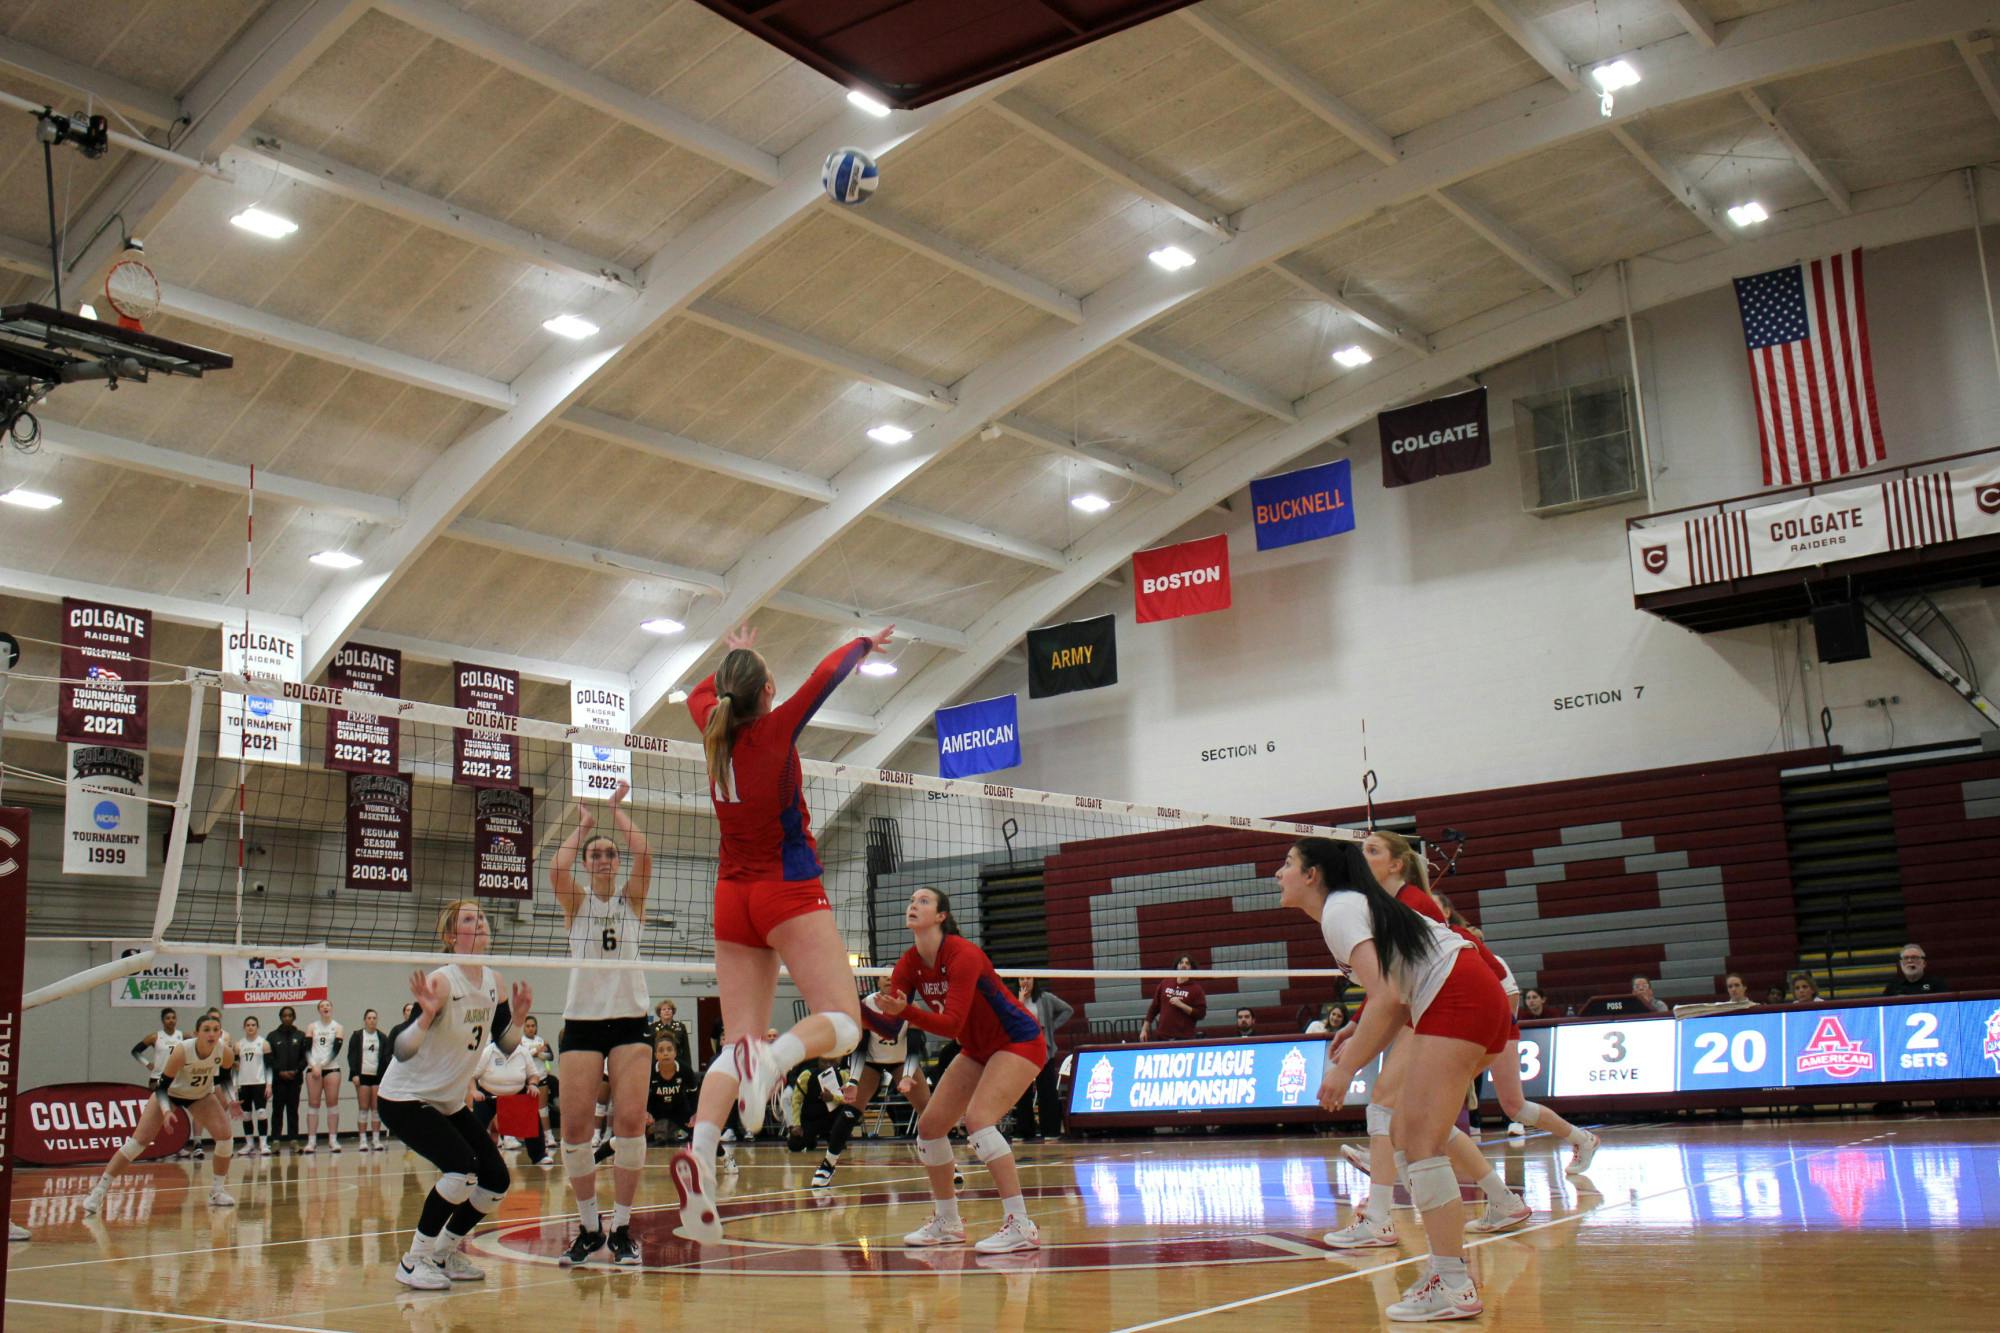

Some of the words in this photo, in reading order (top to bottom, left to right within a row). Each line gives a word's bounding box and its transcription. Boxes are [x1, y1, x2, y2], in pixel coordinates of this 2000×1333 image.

[1392, 422, 1478, 454] COLGATE
[1257, 488, 1344, 524] BUCKNELL
[1770, 507, 1863, 542] COLGATE
[1791, 536, 1846, 552] RAIDERS
[1647, 550, 1664, 568] C
[1143, 566, 1220, 594] BOSTON
[70, 608, 144, 638] COLGATE
[84, 631, 130, 643] RAIDERS
[229, 634, 294, 659] COLGATE
[335, 649, 394, 676] COLGATE
[1051, 645, 1094, 670] ARMY
[346, 669, 382, 681] RAIDERS
[460, 671, 514, 695] COLGATE
[283, 682, 342, 705] COLGATE
[353, 680, 375, 691] MEN'S
[73, 688, 136, 704] TOURNAMENT
[471, 690, 503, 700] RAIDERS
[577, 690, 625, 711] COLGATE
[1554, 689, 1622, 711] SECTION
[1634, 686, 1645, 700] 7
[72, 698, 136, 714] CHAMPIONS
[84, 715, 123, 735] 2021
[466, 711, 517, 731] COLGATE
[244, 734, 277, 750] 2021
[337, 729, 388, 745] CHAMPIONS
[624, 734, 668, 752] COLGATE
[942, 723, 1013, 754] AMERICAN
[464, 740, 510, 751] TOURNAMENT
[1201, 744, 1257, 762] SECTION
[1266, 740, 1276, 753] 6
[335, 744, 390, 764] 2021-22
[464, 748, 510, 761] CHAMPIONS
[462, 760, 512, 780] 2021-22
[578, 761, 626, 774] TOURNAMENT
[588, 775, 617, 790] 2022
[880, 770, 914, 785] COLGATE
[984, 784, 1014, 798] COLGATE
[1076, 796, 1102, 810] COLGATE
[72, 831, 140, 844] TOURNAMENT
[364, 838, 396, 849] SEASON
[88, 848, 126, 864] 1999
[355, 848, 404, 860] CHAMPIONS
[481, 854, 526, 863] TOURNAMENT
[352, 864, 408, 882] 2003-04
[481, 862, 526, 872] CHAMPIONS
[479, 874, 528, 890] 2003-04
[603, 928, 617, 951] 6
[245, 969, 304, 978] PATRIOT
[120, 977, 188, 999] Agency
[245, 978, 304, 988] LEAGUE
[244, 991, 307, 1001] CHAMPIONSHIP
[1606, 1002, 1623, 1010] POSS
[464, 1008, 491, 1024] ARMY
[468, 1025, 482, 1051] 3
[1906, 1012, 1939, 1050] 2
[169, 1046, 175, 1055] 7
[369, 1044, 375, 1052] 4
[1602, 1031, 1627, 1063] 3
[1693, 1030, 1766, 1074] 20
[245, 1052, 254, 1061] 17
[1134, 1052, 1192, 1079] PATRIOT
[1196, 1050, 1255, 1077] LEAGUE
[1801, 1053, 1869, 1068] AMERICAN
[1900, 1052, 1948, 1069] SETS
[190, 1076, 208, 1086] 21
[1589, 1068, 1639, 1082] SERVE
[0, 1012, 12, 1172] EYBALL
[656, 1085, 680, 1095] ARMY
[1130, 1078, 1256, 1108] CHAMPIONSHIPS
[43, 1136, 154, 1150] VOLLEYBA
